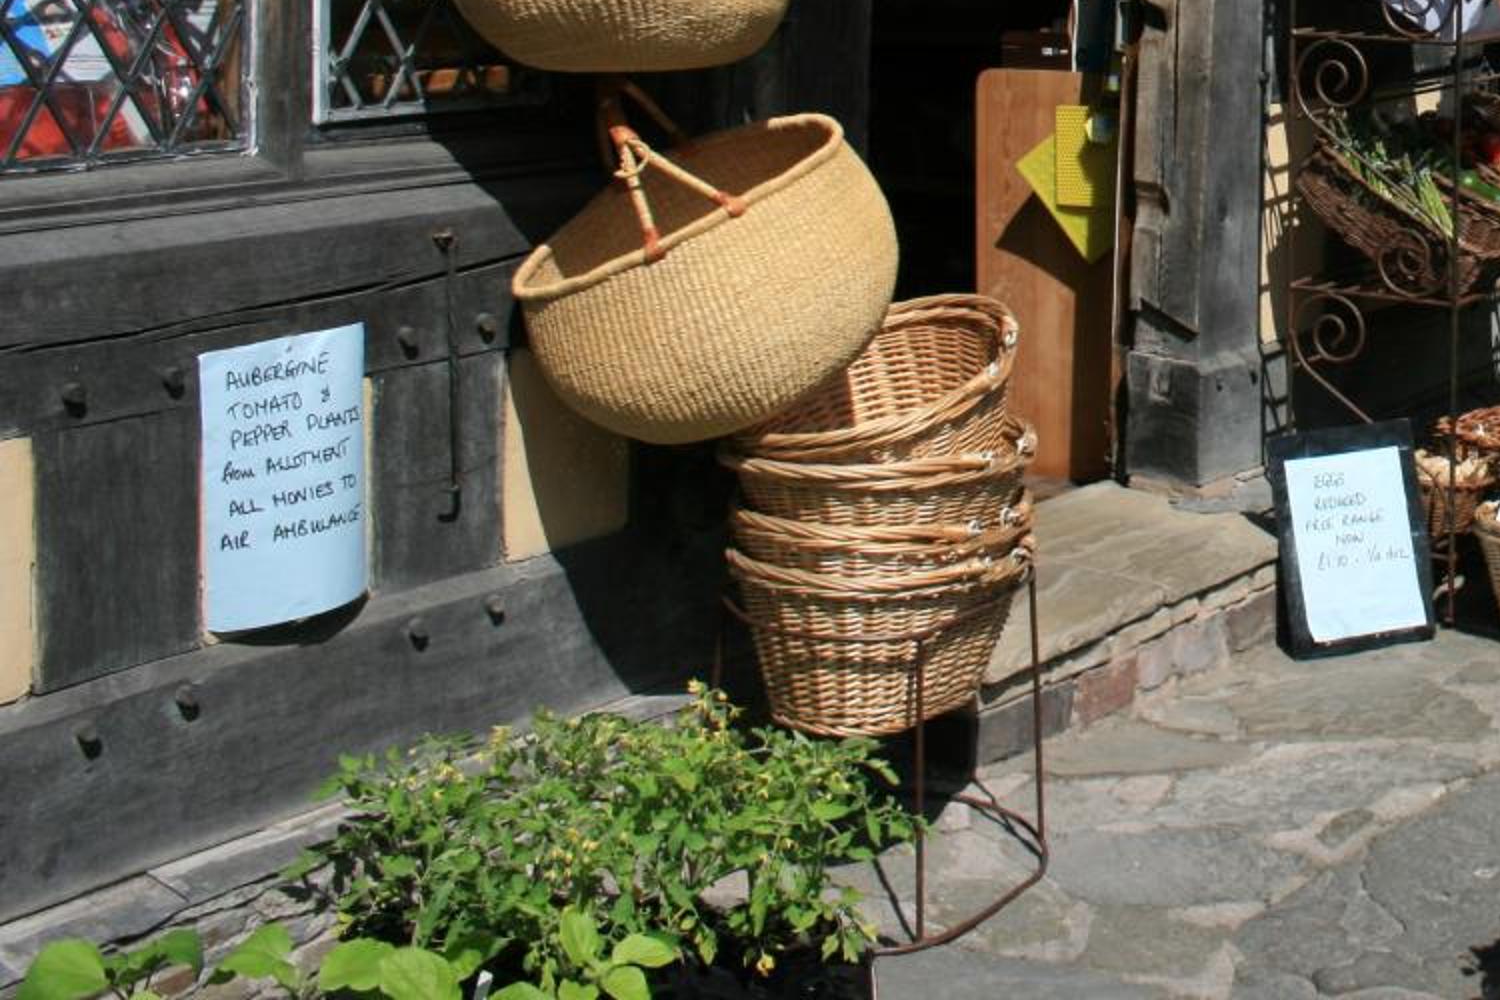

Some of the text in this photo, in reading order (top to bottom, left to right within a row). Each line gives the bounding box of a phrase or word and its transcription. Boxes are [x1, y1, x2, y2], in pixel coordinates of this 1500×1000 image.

[226, 352, 329, 391] AUBERGINE
[227, 392, 303, 420] TOMATO
[230, 405, 360, 450] PEPPER PLANTS
[222, 436, 351, 484] from ALLOTMENT
[229, 473, 357, 517] ALL MONIES TO
[221, 503, 362, 551] AIR AMBULANCE
